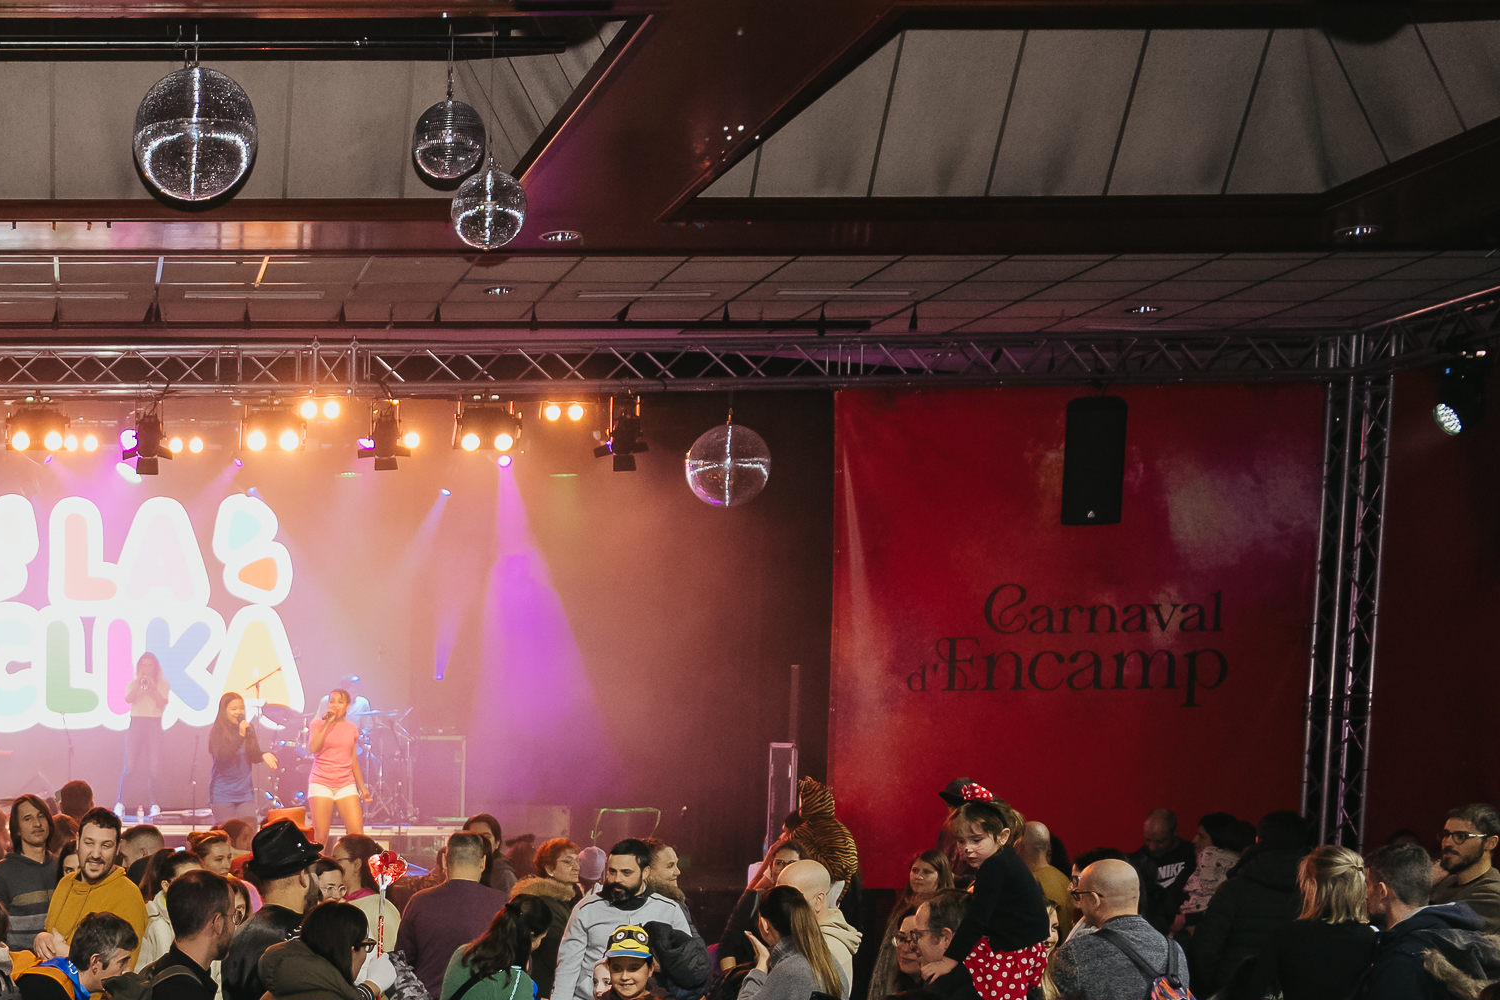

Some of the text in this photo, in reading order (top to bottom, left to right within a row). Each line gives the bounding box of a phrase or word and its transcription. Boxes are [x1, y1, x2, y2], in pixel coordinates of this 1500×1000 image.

[55, 503, 204, 603] LA
[984, 583, 1224, 634] Carnaval
[906, 637, 1229, 707] d'Encamp
[1157, 861, 1185, 880] NIKE
